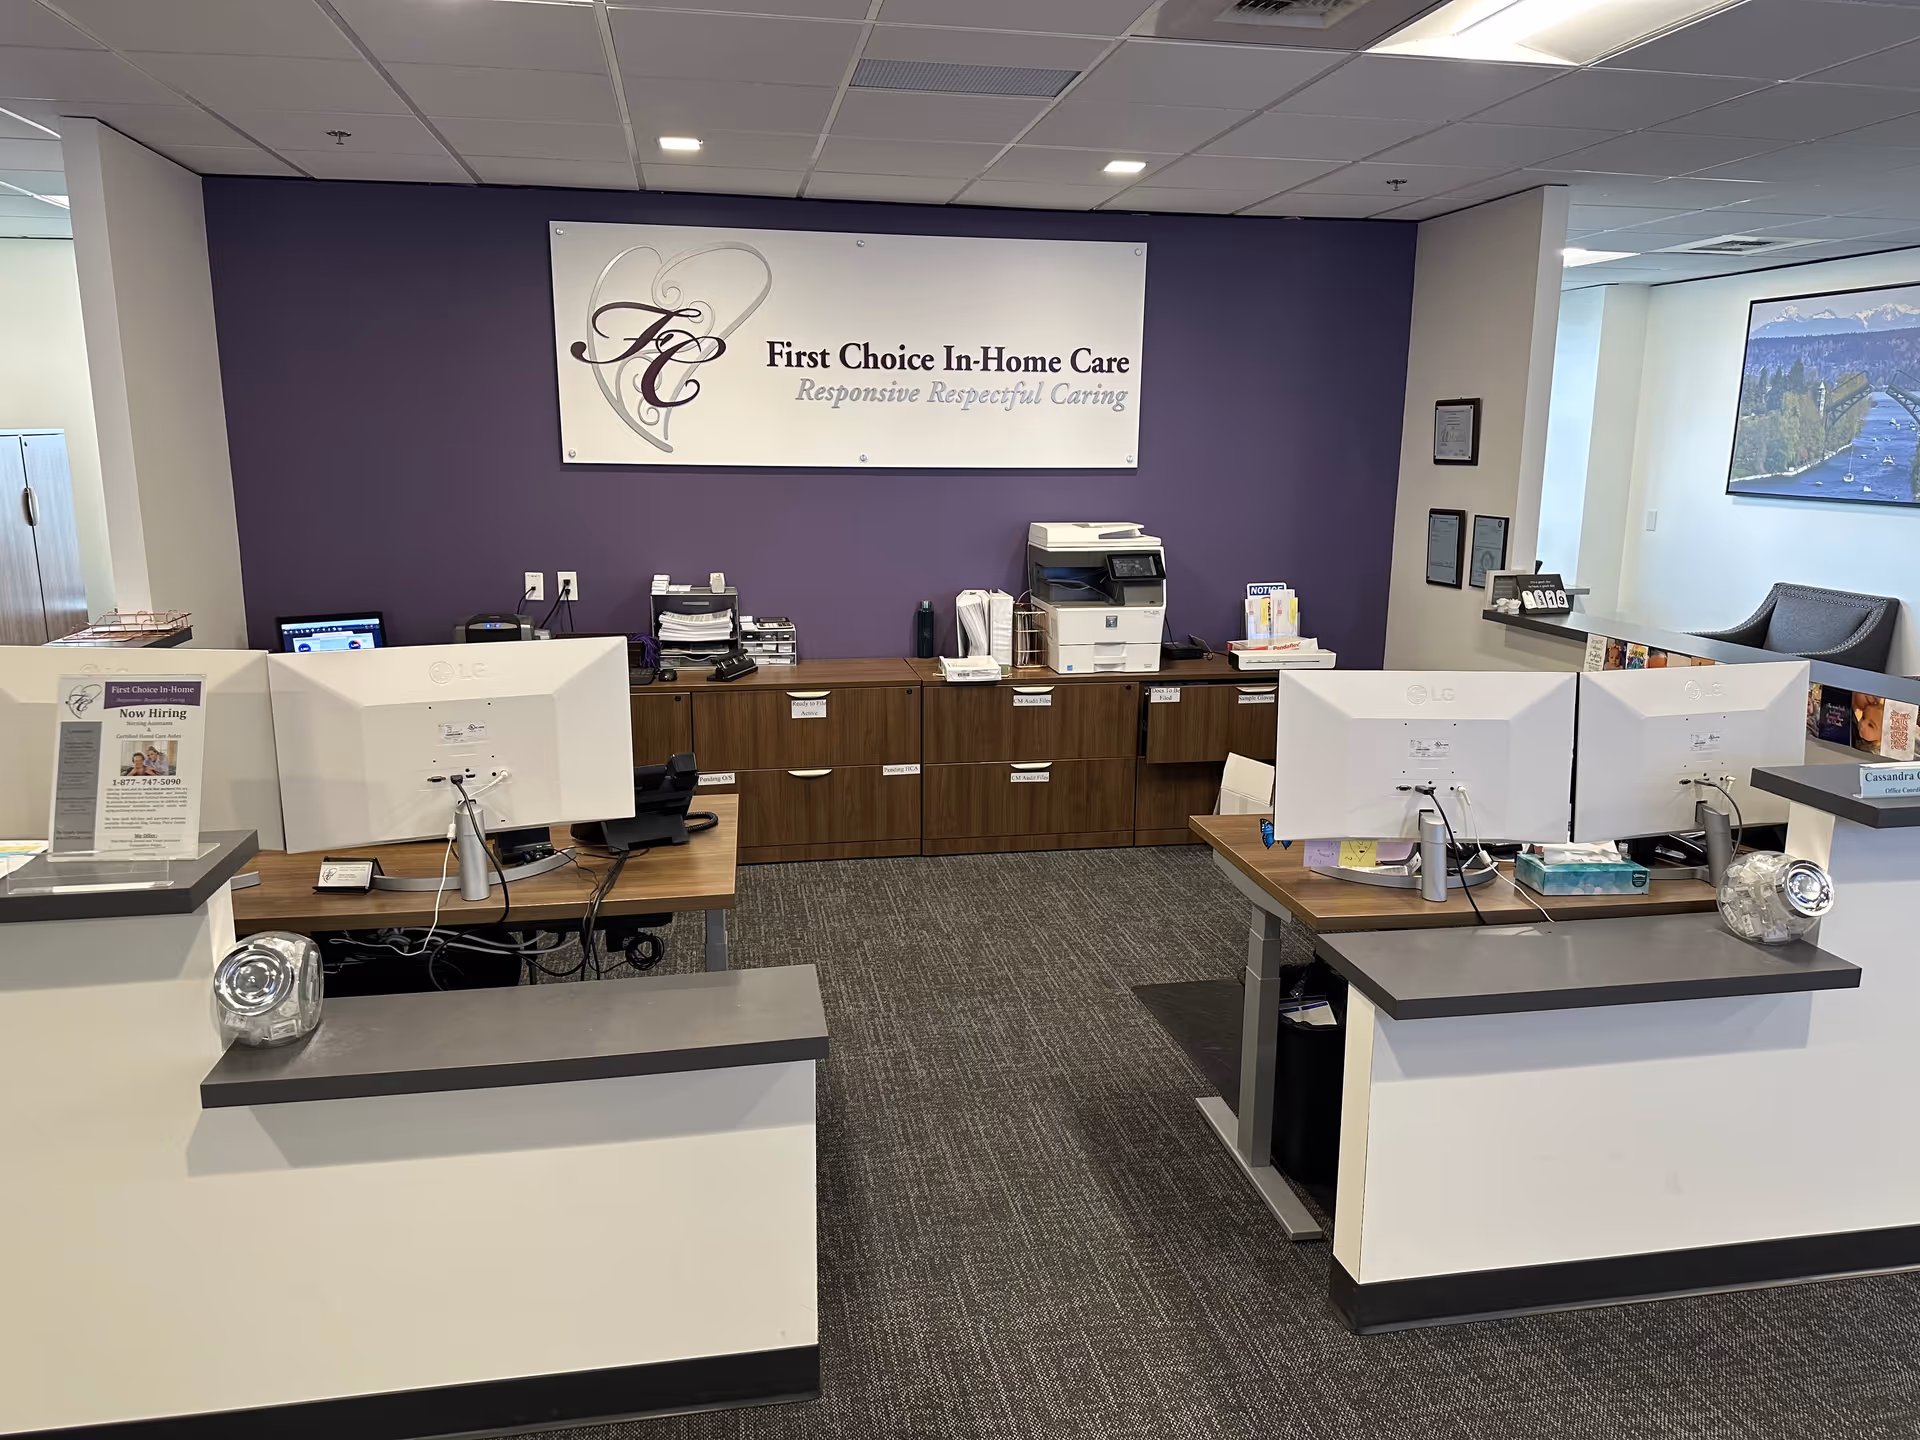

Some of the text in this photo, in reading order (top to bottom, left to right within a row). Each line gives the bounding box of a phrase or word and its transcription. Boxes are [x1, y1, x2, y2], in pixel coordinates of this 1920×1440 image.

[766, 340, 1130, 373] First Choice In-Home Care
[796, 378, 1128, 412] Responsive Respectful Caring
[111, 686, 195, 694] First Choice In-Home
[119, 708, 187, 720] Now Hiring
[142, 778, 181, 786] 747-5090
[1865, 771, 1914, 782] Cassandra
